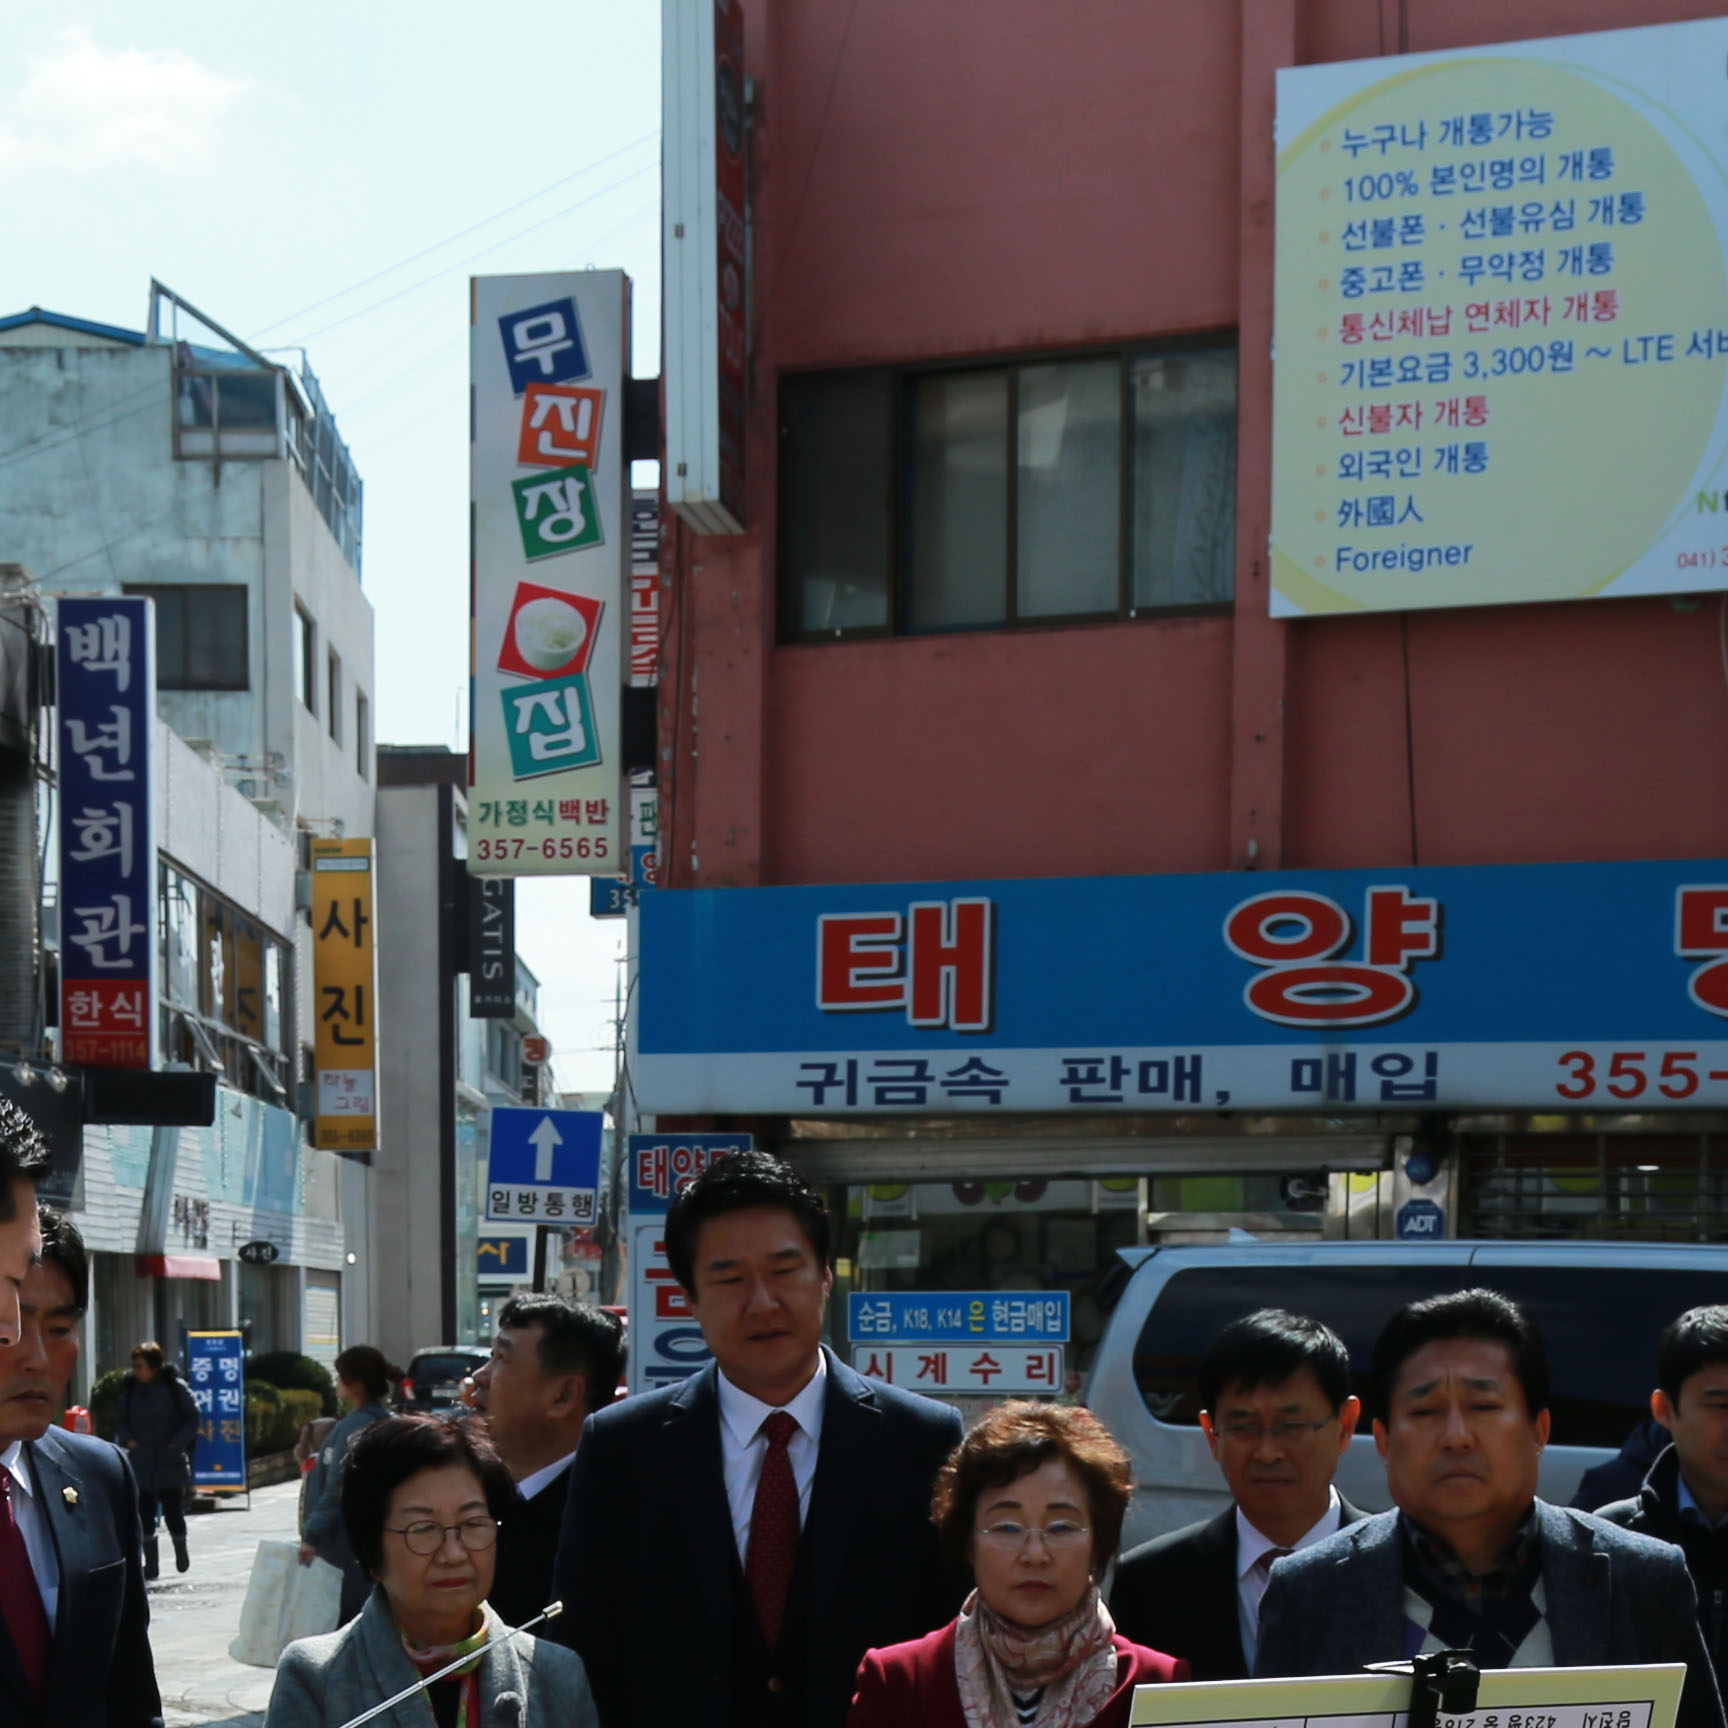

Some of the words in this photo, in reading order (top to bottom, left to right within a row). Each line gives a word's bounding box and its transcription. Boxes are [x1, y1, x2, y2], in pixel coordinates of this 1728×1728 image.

[1342, 121, 1427, 158] 누구나
[1438, 108, 1554, 146] 개통가능
[1343, 169, 1419, 202] 100%
[1430, 153, 1546, 196] 본인명의
[1557, 146, 1615, 182] 개통
[1341, 213, 1426, 251] 선불폰
[1459, 198, 1576, 240] 선불유심
[1587, 190, 1646, 225] 개통
[1340, 260, 1425, 299] 중고폰
[1458, 249, 1546, 286] 무약정
[1557, 241, 1615, 277] 개통
[1339, 303, 1454, 346] 통신체납
[1464, 294, 1552, 333] 연체자
[1562, 289, 1620, 323] 개통
[1339, 351, 1453, 390] 기본요금
[1463, 339, 1575, 380] 3,300원
[1622, 332, 1675, 366] LTE
[1338, 402, 1424, 437] 신불자
[1432, 394, 1491, 429] 개통
[1337, 446, 1423, 483] 외국인
[1432, 441, 1490, 475] 개통
[1336, 494, 1426, 531] 外國人
[1335, 543, 1475, 574] Foreigner
[513, 686, 586, 762] 집
[63, 611, 147, 971] 백년회관
[478, 799, 610, 826] 가정식백반
[477, 836, 609, 861] 357-6565
[320, 897, 370, 1047] 사진
[66, 990, 144, 1029] 한식
[796, 1054, 1011, 1109] 귀금속
[1059, 1052, 1232, 1107] 판매,
[1289, 1049, 1441, 1104] 매입
[490, 1189, 594, 1220] 일방통행
[1403, 1215, 1438, 1233] ADT
[857, 1300, 898, 1333] 순금,
[903, 1308, 933, 1331] K18,
[937, 1308, 963, 1330] K14
[968, 1300, 986, 1333] 은
[991, 1299, 1062, 1333] 현금매입
[190, 1357, 240, 1384] 증명
[863, 1351, 1056, 1386] 시계수리
